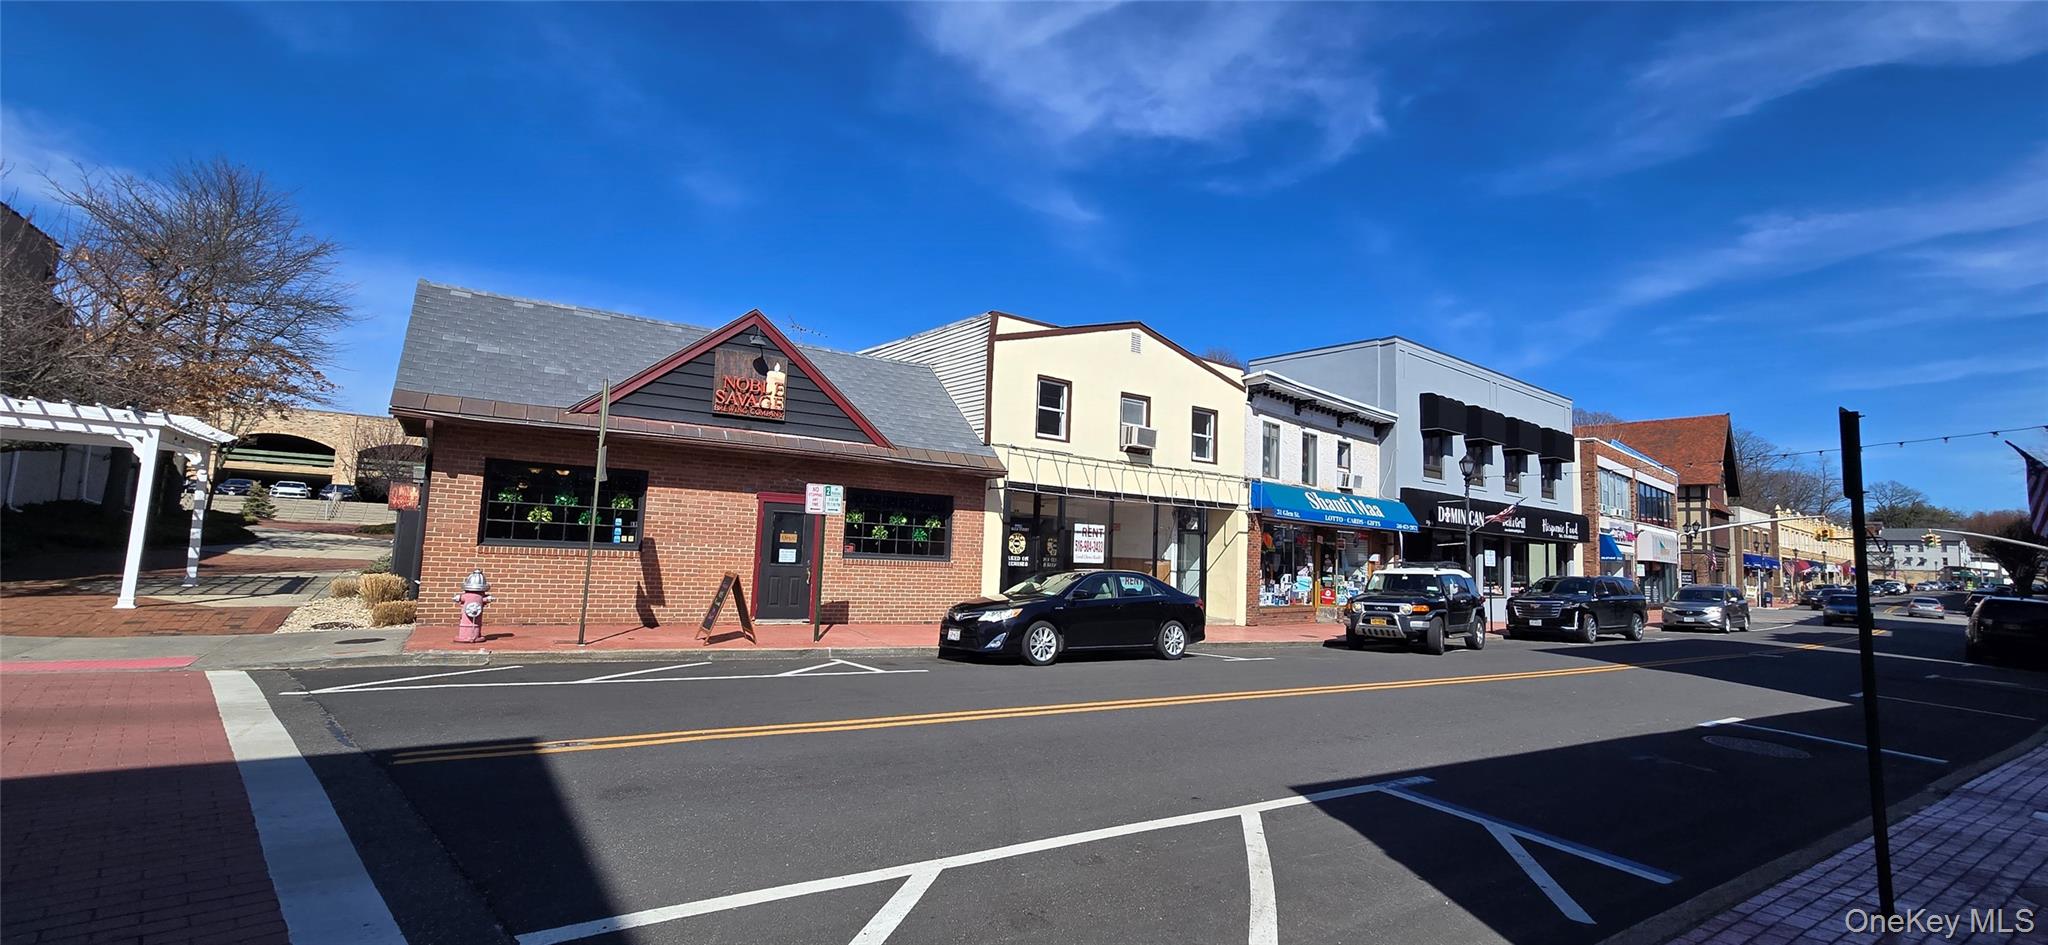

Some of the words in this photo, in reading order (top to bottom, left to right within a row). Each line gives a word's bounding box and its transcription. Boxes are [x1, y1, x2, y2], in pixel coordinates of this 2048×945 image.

[723, 375, 785, 396] NOBLE
[715, 389, 784, 410] SAVAGE
[714, 403, 747, 415] BREWING
[749, 408, 785, 419] COMPANY
[1282, 509, 1294, 517] Glen
[1304, 491, 1355, 515] Shanti
[1350, 498, 1385, 518] Maa
[1324, 515, 1344, 523] LOTTO
[1346, 517, 1364, 525] CARDS
[1366, 519, 1381, 527] GIFTS
[1542, 518, 1565, 536] Hispanic
[1565, 521, 1579, 535] Food
[1081, 526, 1104, 538] RENT
